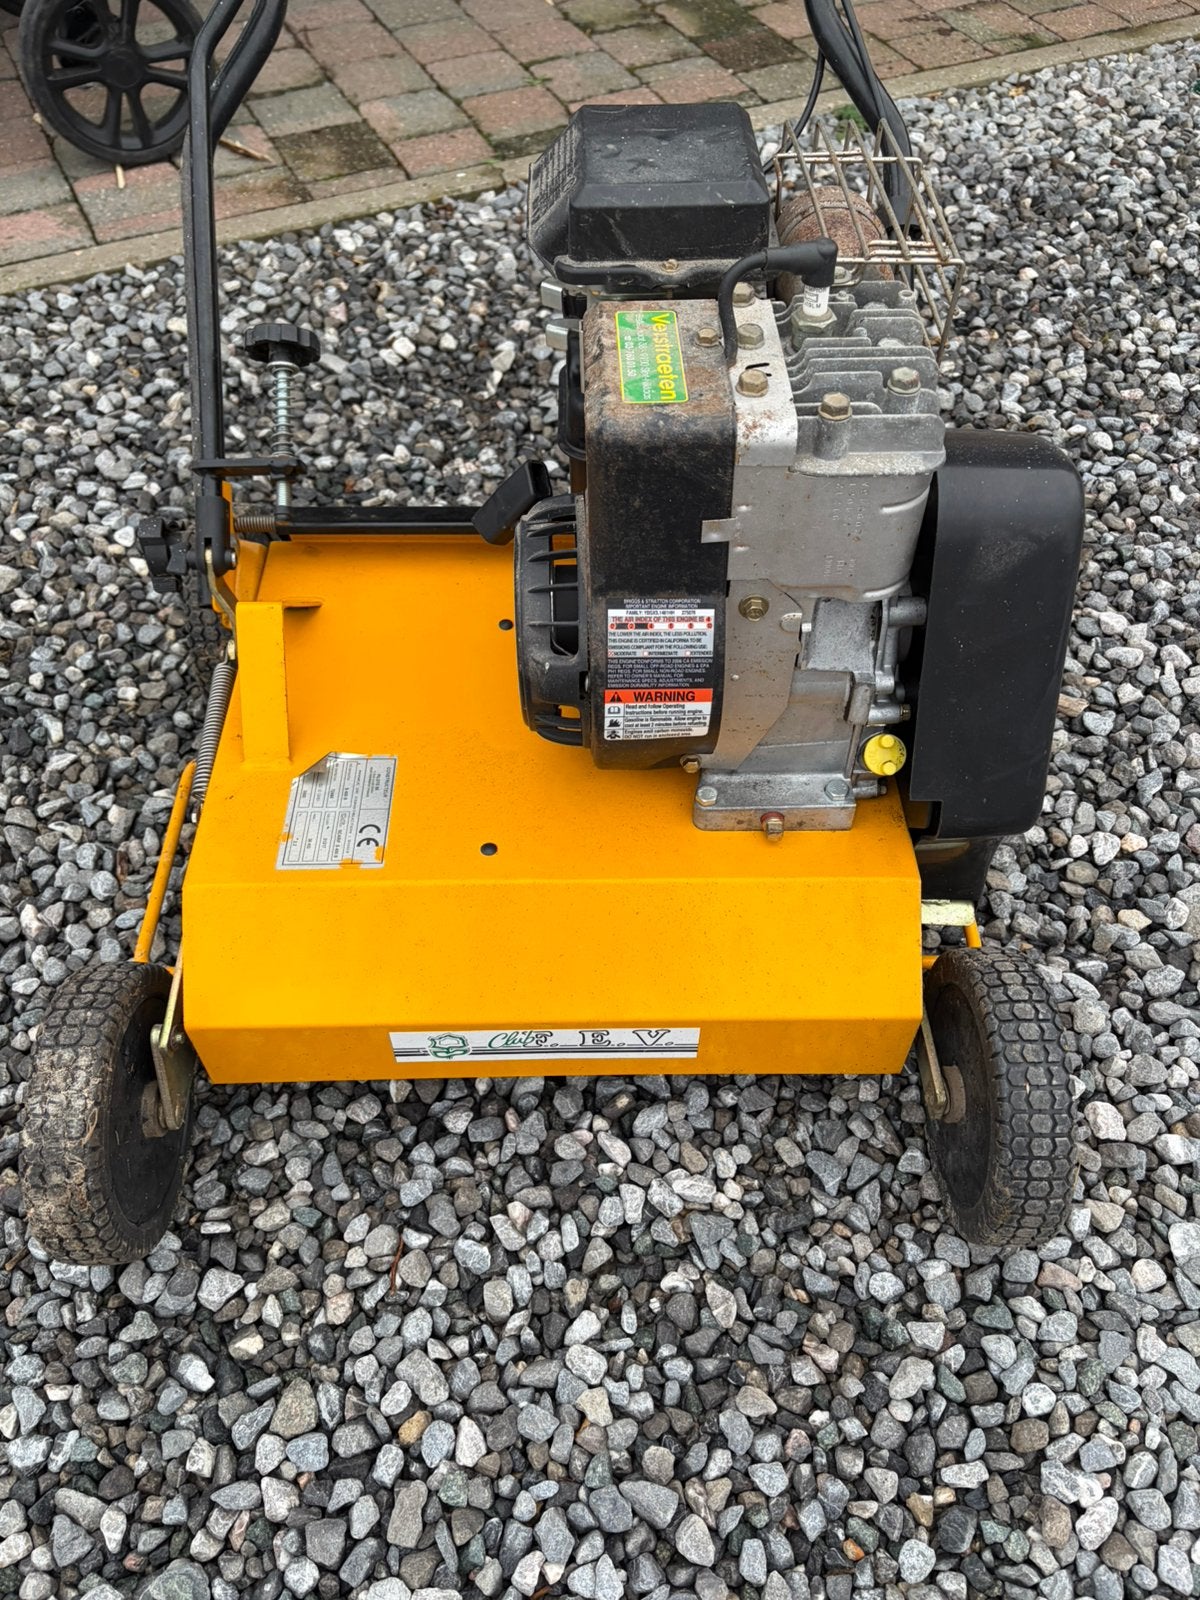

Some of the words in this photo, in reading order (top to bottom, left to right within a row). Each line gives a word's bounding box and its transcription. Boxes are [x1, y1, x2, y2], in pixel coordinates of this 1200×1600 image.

[652, 314, 678, 400] Verstraeten
[634, 691, 695, 702] WARNING
[382, 766, 391, 797] CONSTRUCTEUR
[488, 1030, 534, 1048] Club
